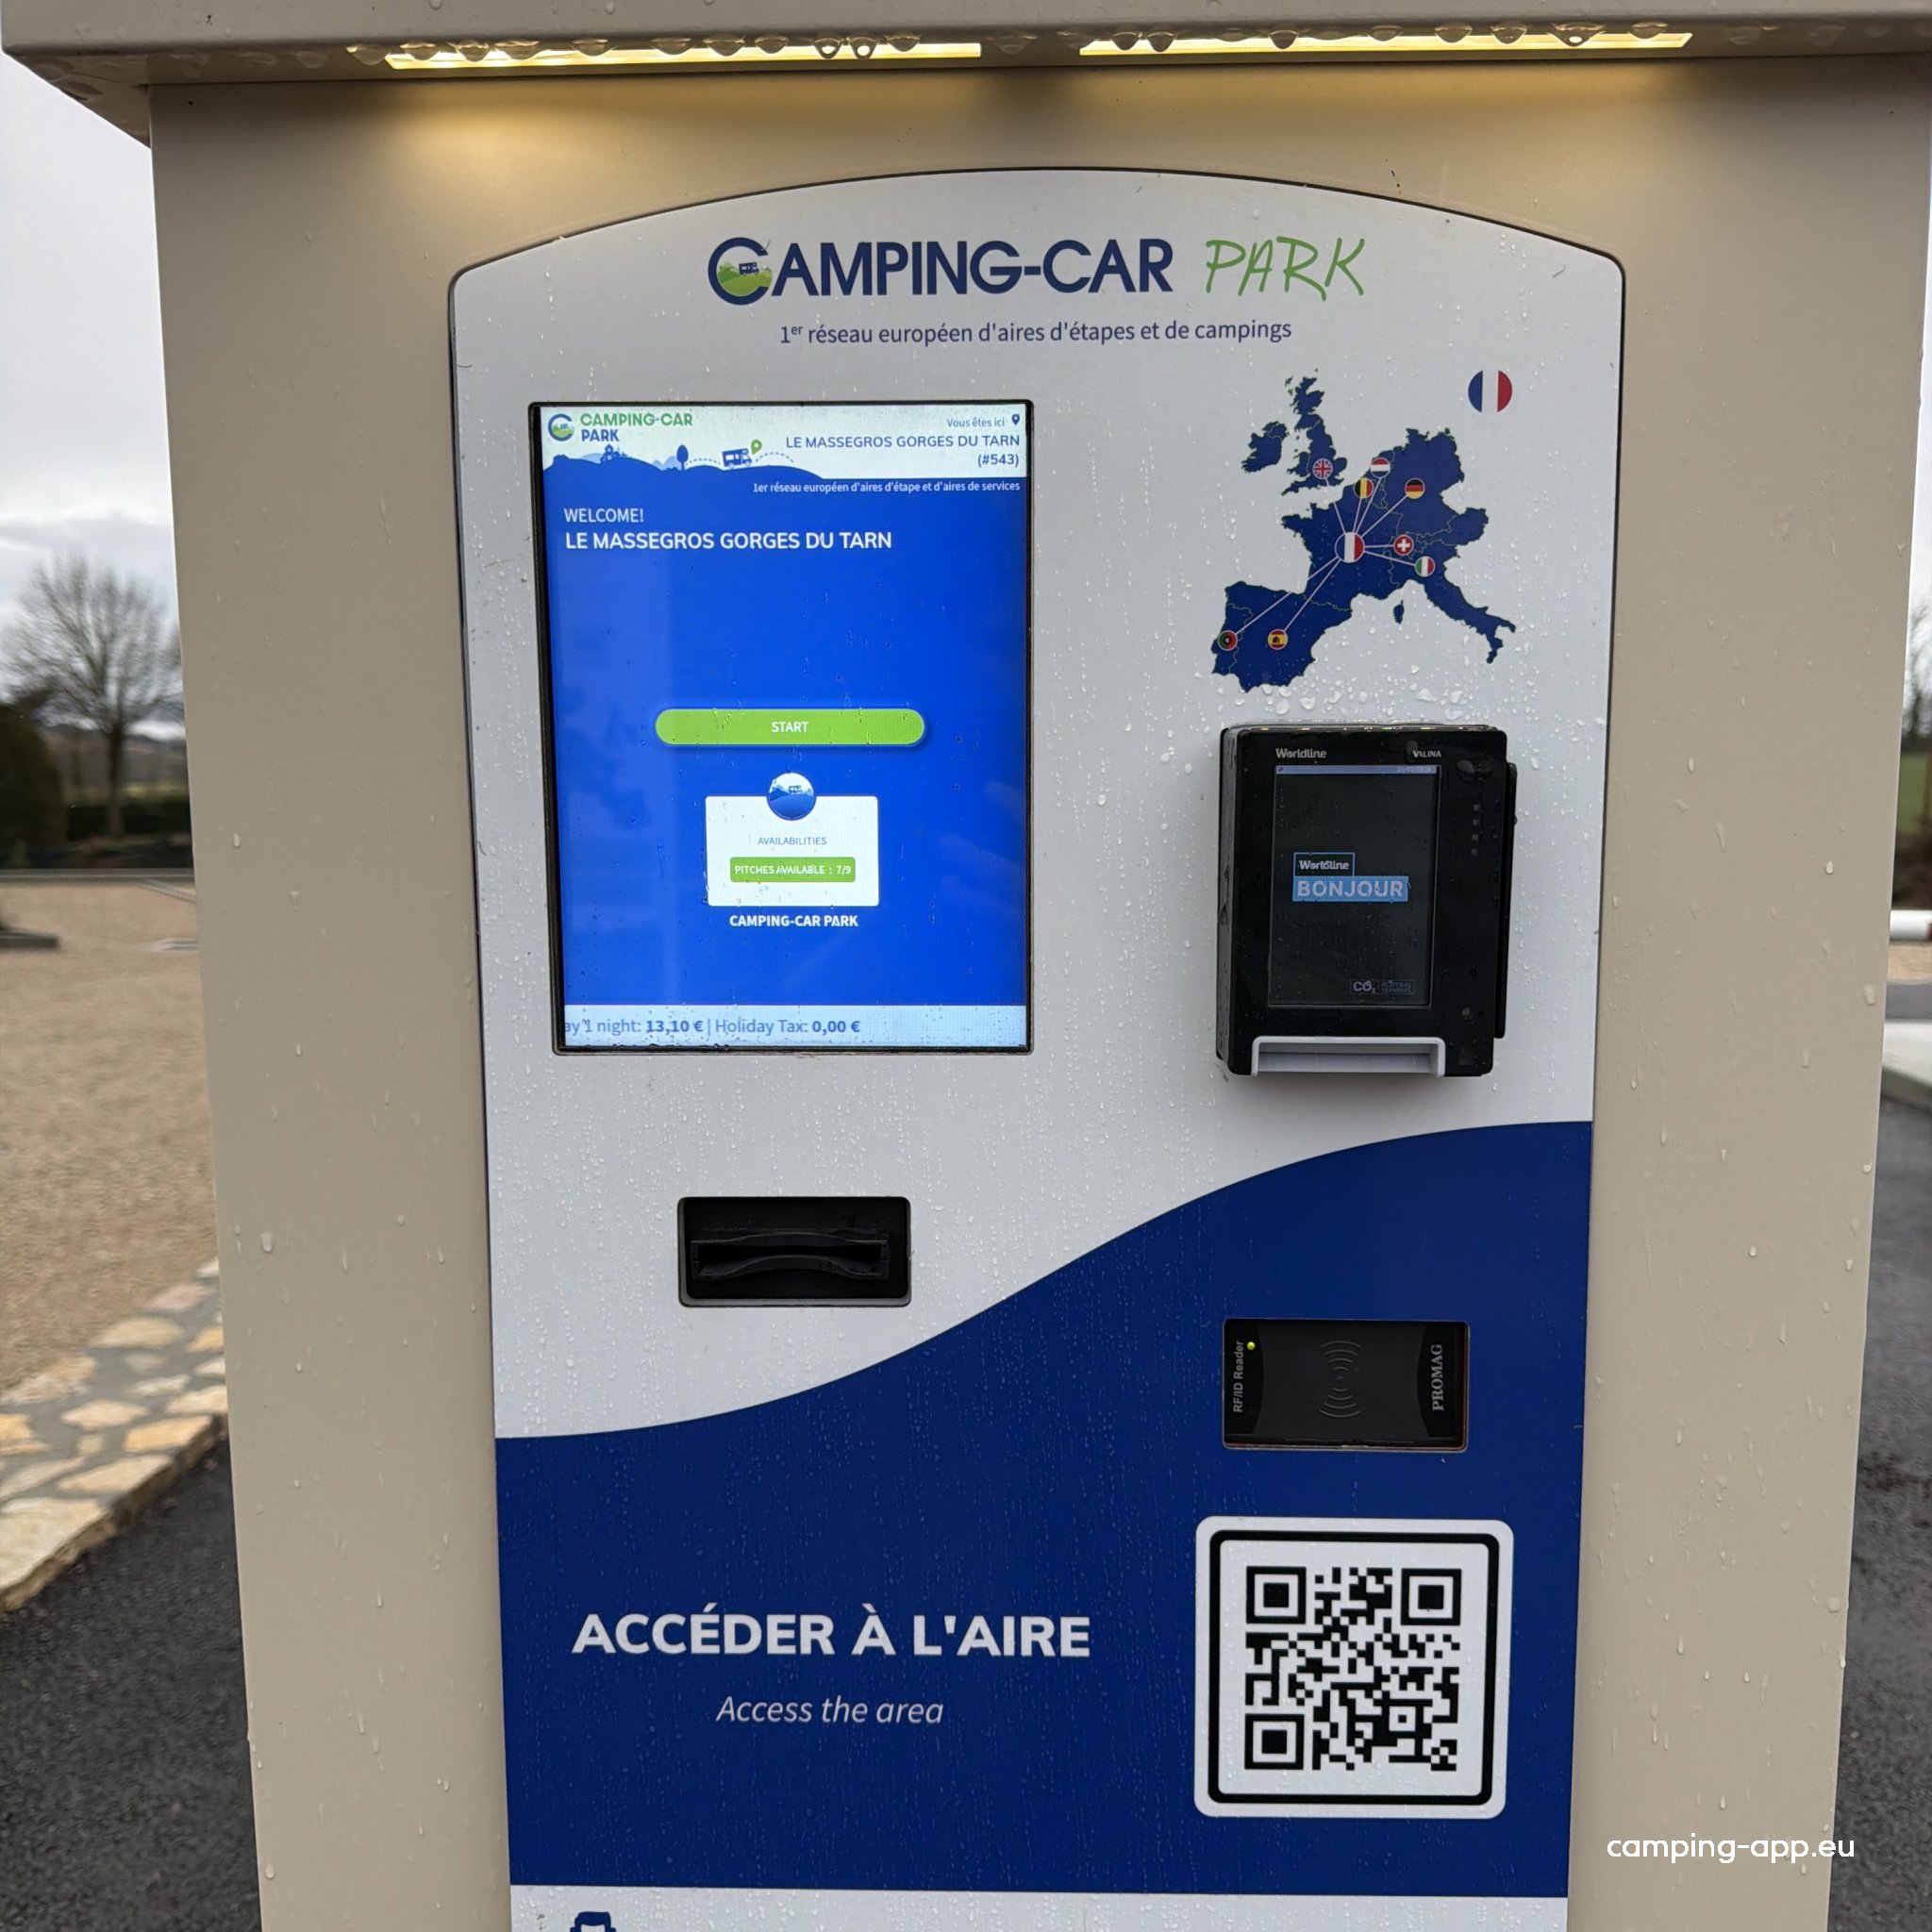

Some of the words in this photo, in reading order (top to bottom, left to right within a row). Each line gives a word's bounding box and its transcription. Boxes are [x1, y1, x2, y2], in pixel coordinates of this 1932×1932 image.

[708, 237, 1174, 305] CAMPING-CAR
[1205, 237, 1367, 301] PARK
[808, 322, 873, 344] réseau
[878, 322, 973, 348] européen
[978, 321, 1044, 342] d'aires
[1050, 320, 1134, 346] d'étapes
[1140, 325, 1160, 341] et
[1164, 320, 1190, 341] de
[1194, 319, 1292, 345] campings
[580, 412, 693, 426] CAMPING-CAR
[947, 418, 970, 427] Vous
[973, 416, 991, 427] êtes
[993, 417, 1005, 427] ici
[581, 429, 620, 441] PARK
[786, 437, 802, 448] LE
[806, 436, 892, 448] MASSEGROS
[896, 436, 954, 447] GORGES
[958, 435, 978, 447] DU
[981, 435, 1021, 446] TARN
[977, 454, 1020, 468] (#543)
[753, 482, 768, 492] 1er
[770, 482, 802, 492] réseau
[803, 482, 849, 494] européen
[851, 481, 883, 492] d'aires
[885, 481, 921, 494] d'étape
[923, 483, 932, 492] et
[934, 481, 966, 492] d'aires
[968, 481, 980, 491] de
[982, 481, 1021, 491] services
[564, 508, 644, 524] WELCOME!
[565, 532, 588, 549] LE
[592, 532, 715, 549] MASSEGROS
[720, 531, 800, 549] GORGES
[806, 531, 834, 549] DU
[839, 531, 891, 549] TARN
[771, 721, 809, 733] START
[1274, 747, 1327, 759] Worldline
[1412, 749, 1442, 758] VALINA
[758, 836, 827, 846] AVAILABILITIES
[735, 864, 774, 875] PITCHES
[775, 864, 825, 875] AVAILABLE
[836, 864, 852, 875] 7/9
[1296, 879, 1404, 897] BONJOUR
[729, 914, 821, 927] CAMPING-CAR
[824, 914, 859, 927] PARK
[584, 1019, 592, 1033] 1
[597, 1018, 642, 1036] night:
[645, 1020, 691, 1035] 13,10
[693, 1020, 704, 1033] €
[715, 1018, 774, 1036] Holiday
[777, 1019, 808, 1033] Tax:
[811, 1020, 847, 1036] 0,00
[850, 1020, 861, 1033] €
[1233, 1340, 1244, 1378] Reader
[1430, 1343, 1445, 1412] PROMAG
[1232, 1380, 1243, 1413] RF/ID
[571, 1602, 836, 1657] ACCÉDER
[851, 1602, 897, 1657] À
[913, 1614, 1091, 1658] L'AIRE
[716, 1695, 814, 1724] Access
[820, 1694, 870, 1724] the
[875, 1699, 944, 1725] area
